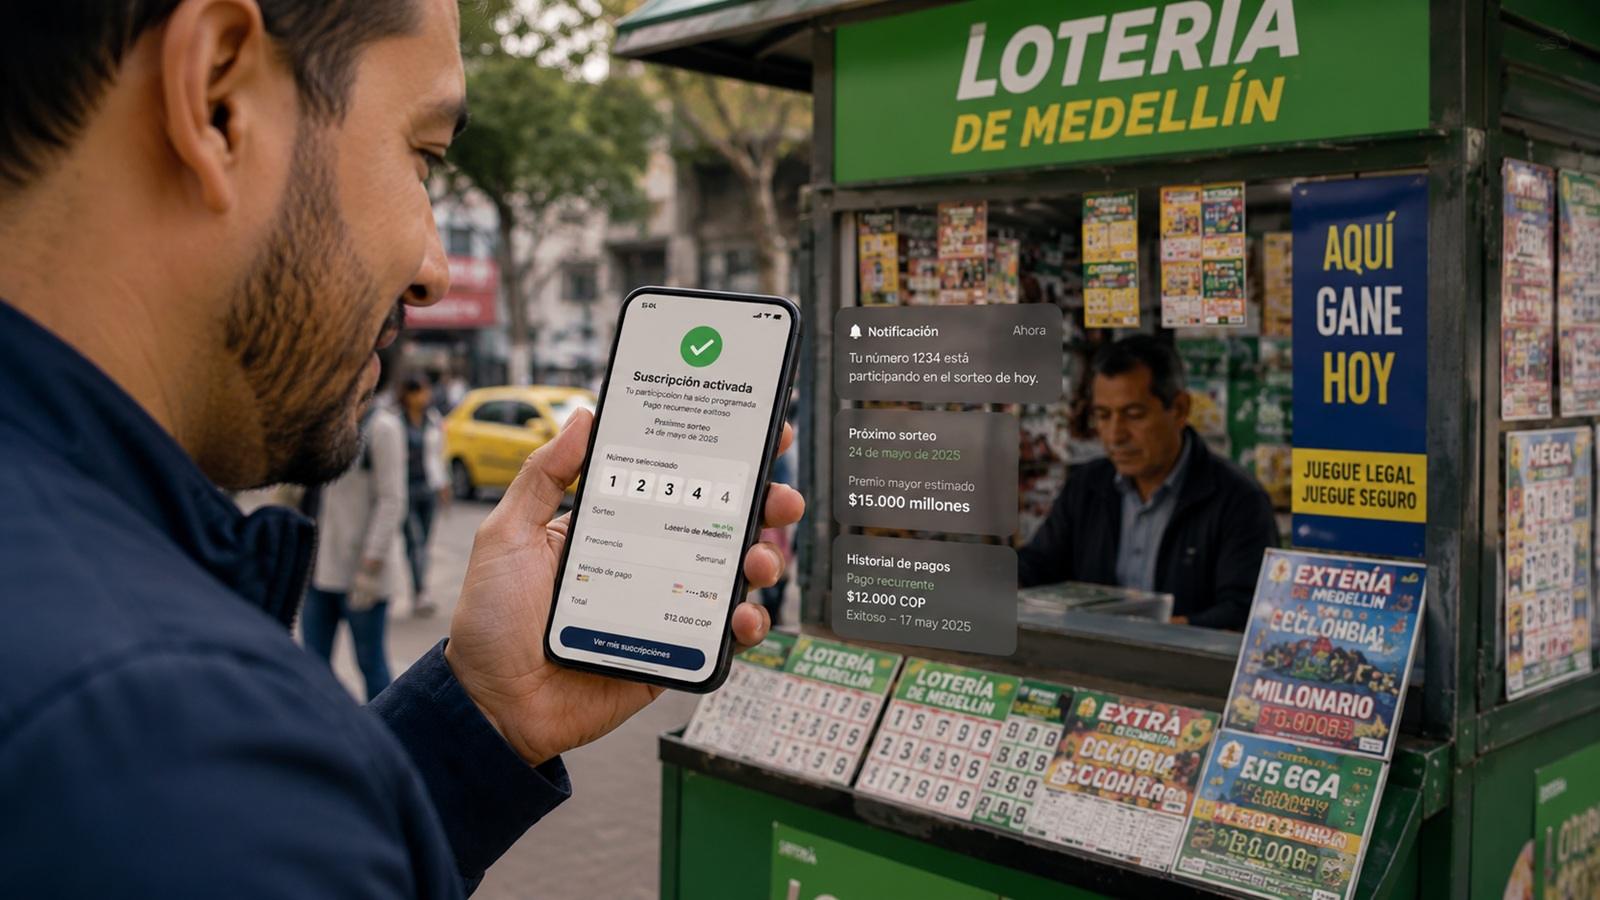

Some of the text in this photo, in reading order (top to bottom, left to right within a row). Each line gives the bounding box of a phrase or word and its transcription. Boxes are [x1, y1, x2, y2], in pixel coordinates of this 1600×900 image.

[951, 69, 1285, 154] DE MEDELLÍN
[1323, 211, 1396, 275] AQUÍ
[1316, 286, 1402, 336] GANE
[633, 371, 753, 394] Suscripción activada
[1323, 351, 1395, 405] HOY
[656, 429, 666, 437] de
[667, 431, 686, 440] mayo
[688, 433, 698, 441] de
[686, 422, 711, 432] sorteo
[1527, 441, 1573, 466] MEGA
[1303, 460, 1416, 485] JUEGUE LEGAL
[610, 475, 730, 504] 1 2 3 4 4
[1302, 485, 1417, 510] JUEGUE SEGURO
[592, 506, 615, 517] Sorteo
[614, 570, 632, 580] pago
[1294, 565, 1393, 594] EXTERÍA
[571, 596, 588, 606] Total
[593, 638, 606, 647] Ver
[803, 646, 876, 674] LOTERÍA
[906, 686, 925, 700] DE
[916, 669, 995, 699] LOTERÍA
[1252, 678, 1375, 720] MILLONARIO
